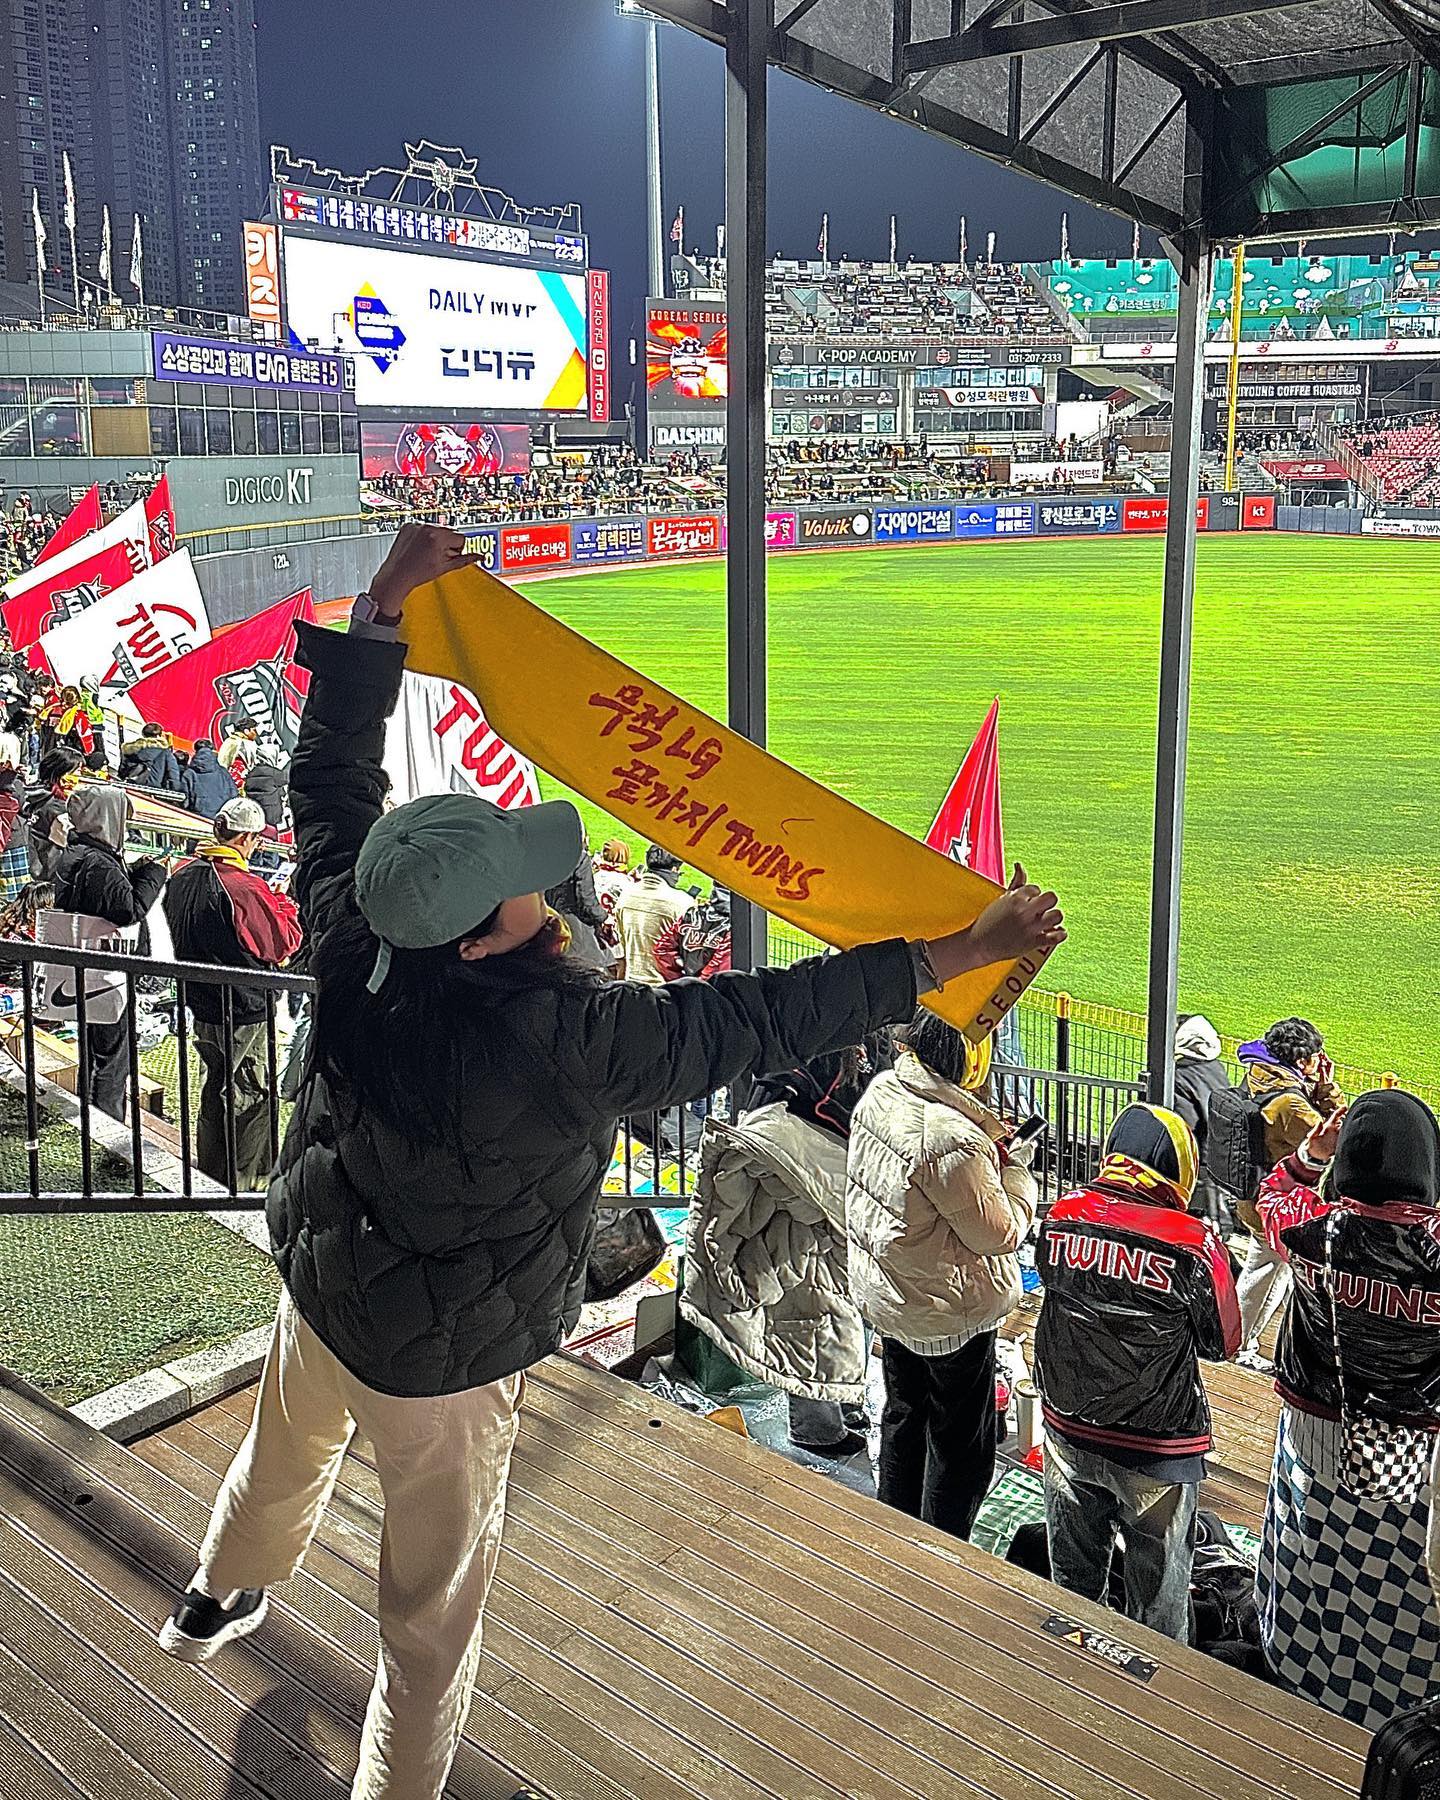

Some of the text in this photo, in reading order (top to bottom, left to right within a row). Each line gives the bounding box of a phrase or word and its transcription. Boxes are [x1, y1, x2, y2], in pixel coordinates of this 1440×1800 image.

[429, 288, 485, 313] DAILY
[593, 275, 603, 344] 대신증권
[650, 310, 727, 324] KOREAN SERIES
[162, 343, 227, 376] 소상공인과
[228, 350, 254, 378] 함께
[255, 351, 290, 384] ENA
[818, 350, 917, 363] K-POP ACADEMY
[967, 390, 1029, 403] 성모척관병원
[1277, 385, 1311, 396] COFFEE
[1313, 383, 1362, 397] ROASTERS
[657, 427, 724, 445] DAISHIN
[225, 468, 314, 505] DIGICO KT
[1041, 505, 1117, 527] 광신프로그레스
[1252, 505, 1266, 517] kt
[652, 521, 714, 552] 본수원갈비
[803, 519, 851, 537] Volvik
[506, 544, 540, 561] skylife
[541, 541, 567, 558] 모바일
[116, 602, 172, 674] TWI
[588, 684, 723, 780] 무적 LG
[433, 685, 533, 809] TWI
[606, 758, 825, 900] 끝까지 TWINS
[1045, 1230, 1176, 1294] TWINS
